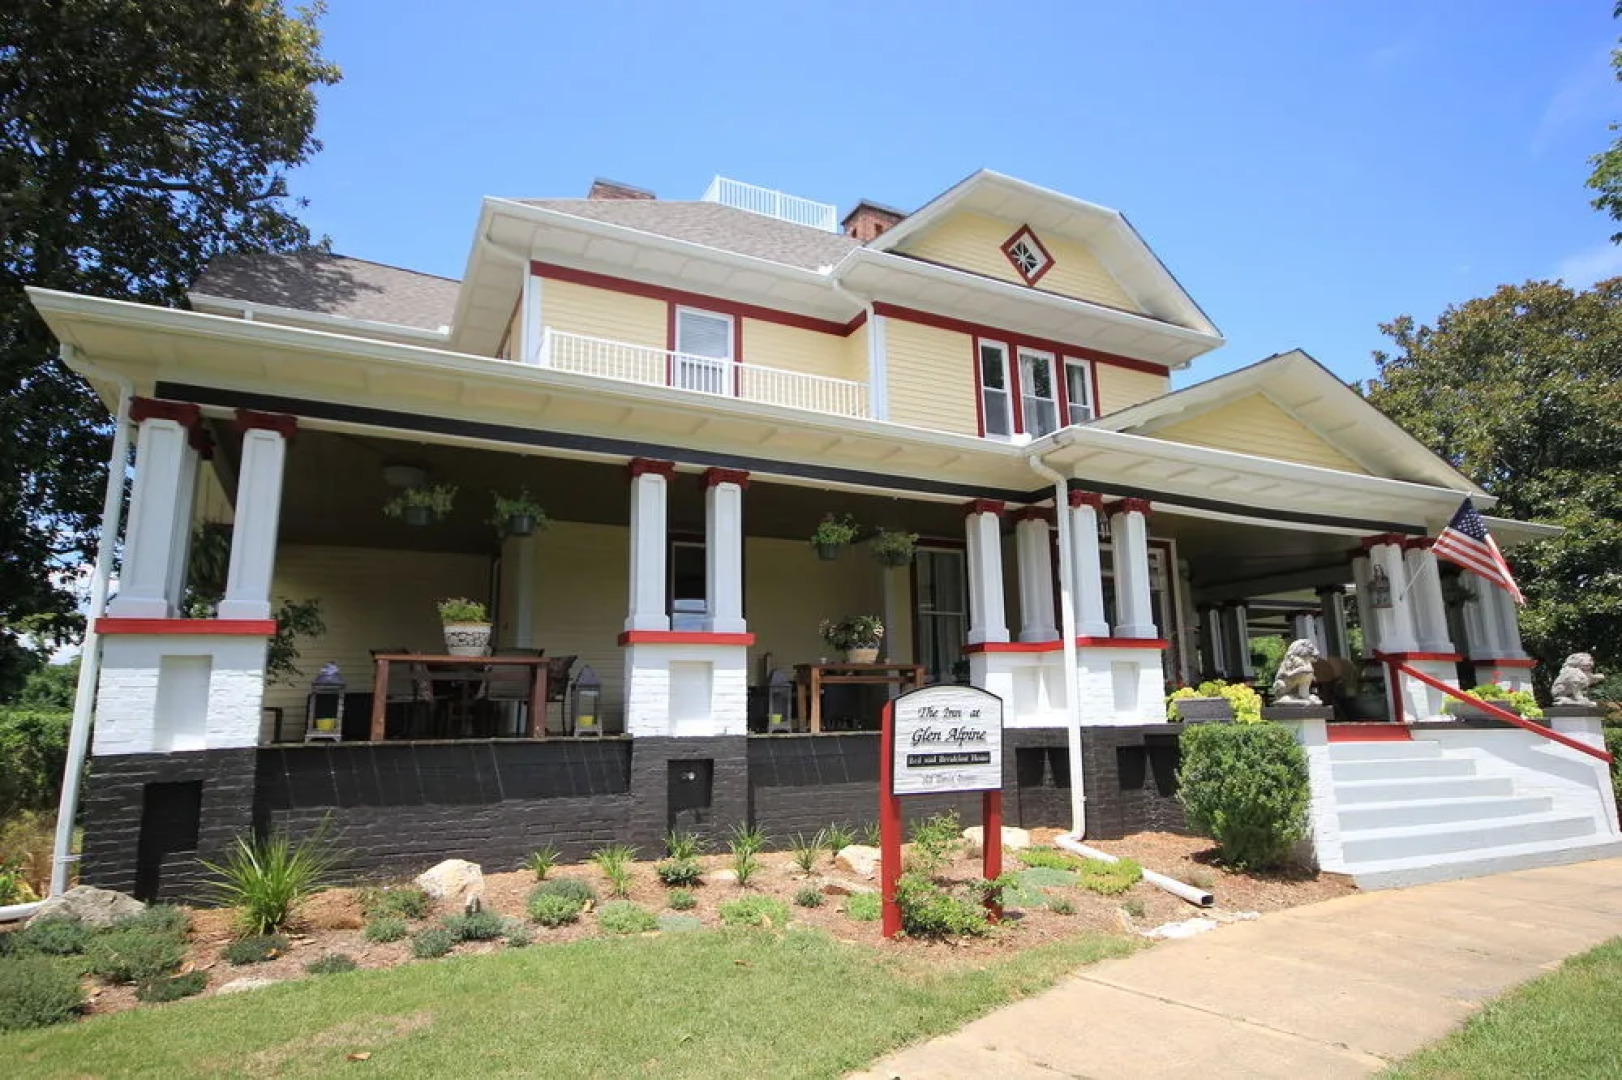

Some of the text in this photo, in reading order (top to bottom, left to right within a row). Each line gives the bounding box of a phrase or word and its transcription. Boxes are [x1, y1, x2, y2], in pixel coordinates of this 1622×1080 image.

[918, 706, 980, 718] The Inn at
[912, 726, 986, 747] Glen Alpine
